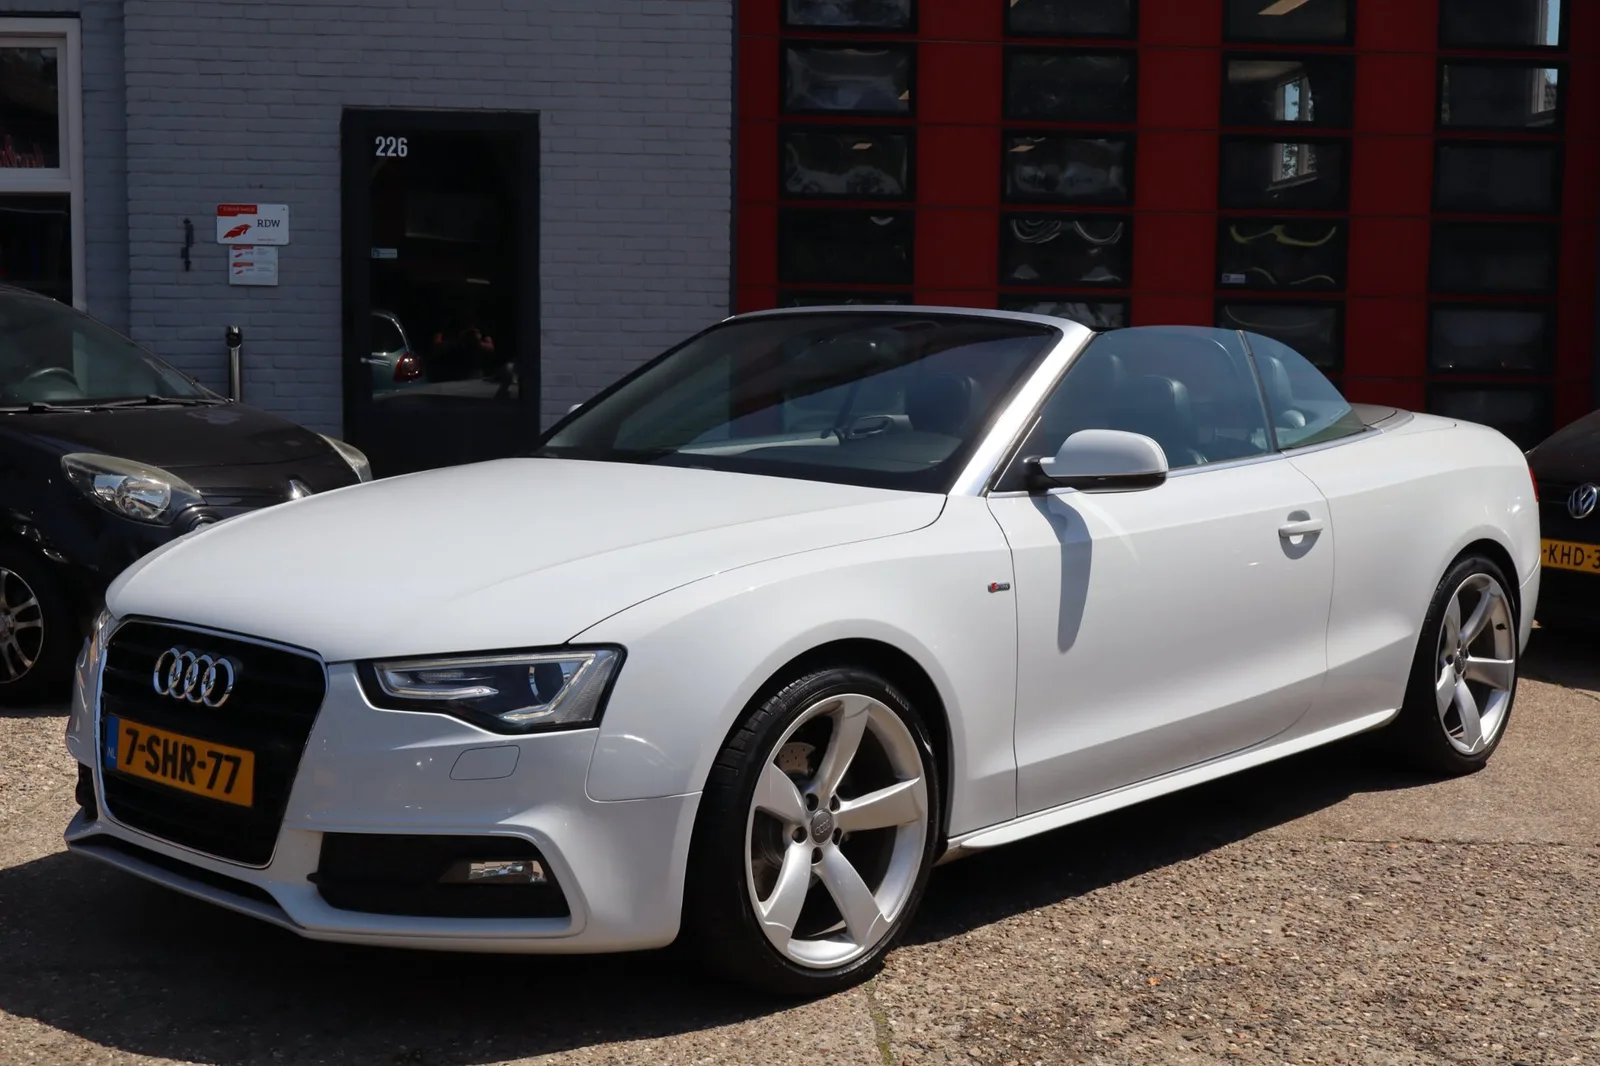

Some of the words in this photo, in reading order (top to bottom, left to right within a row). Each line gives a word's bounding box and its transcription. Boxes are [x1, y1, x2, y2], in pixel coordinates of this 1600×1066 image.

[375, 136, 408, 157] 226
[257, 219, 281, 228] RDW
[107, 747, 117, 759] NL
[125, 728, 242, 794] 7-SHR-77
